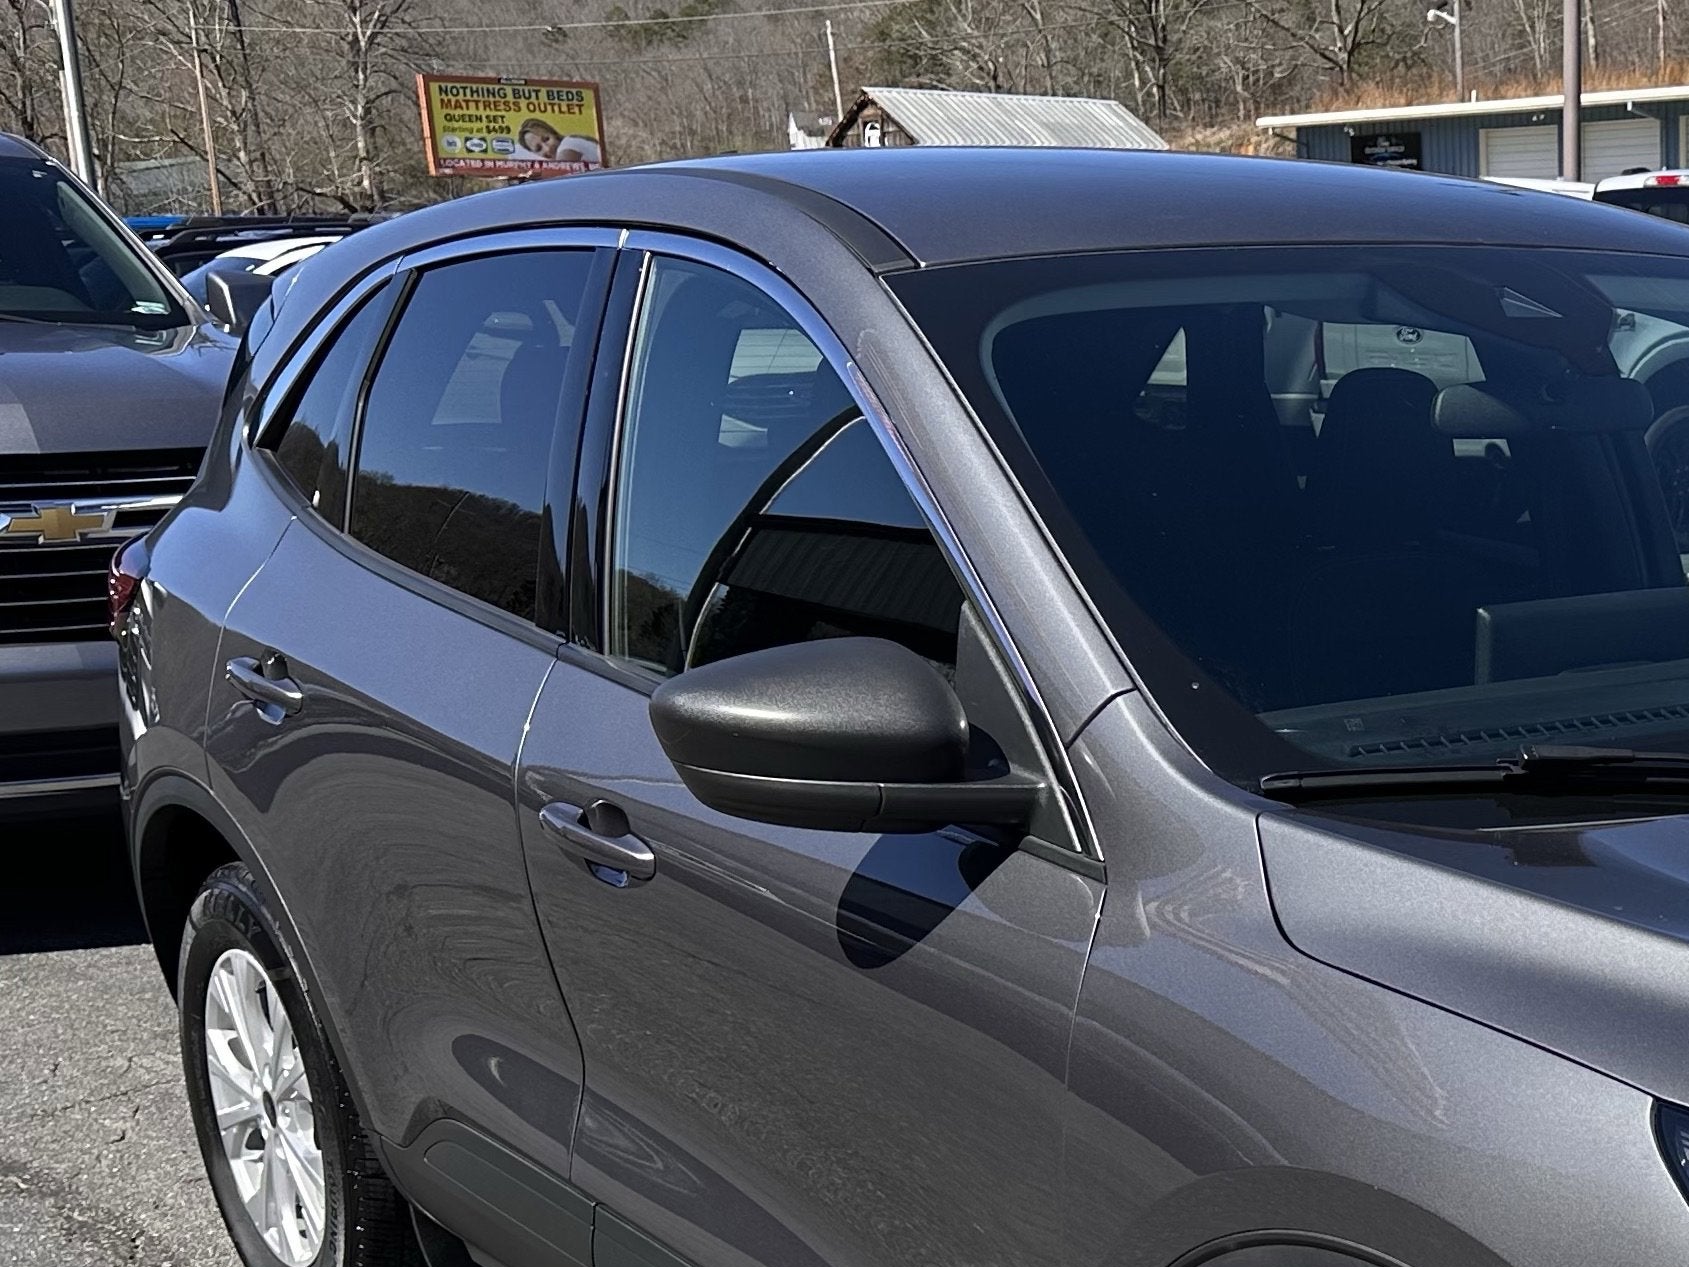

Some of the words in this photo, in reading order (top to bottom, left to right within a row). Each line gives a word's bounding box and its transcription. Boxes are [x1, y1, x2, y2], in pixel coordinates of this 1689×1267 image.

[438, 84, 508, 99] NOTHING
[511, 88, 541, 101] BUT
[546, 89, 585, 103] BEDS
[440, 98, 522, 113] MATTRESS
[526, 101, 585, 116] OUTLET
[444, 113, 483, 123] QUEEN
[485, 115, 506, 124] SET
[443, 125, 474, 135] Starting
[485, 125, 512, 135] $499
[440, 159, 483, 169] LOCATED
[484, 160, 494, 169] IN
